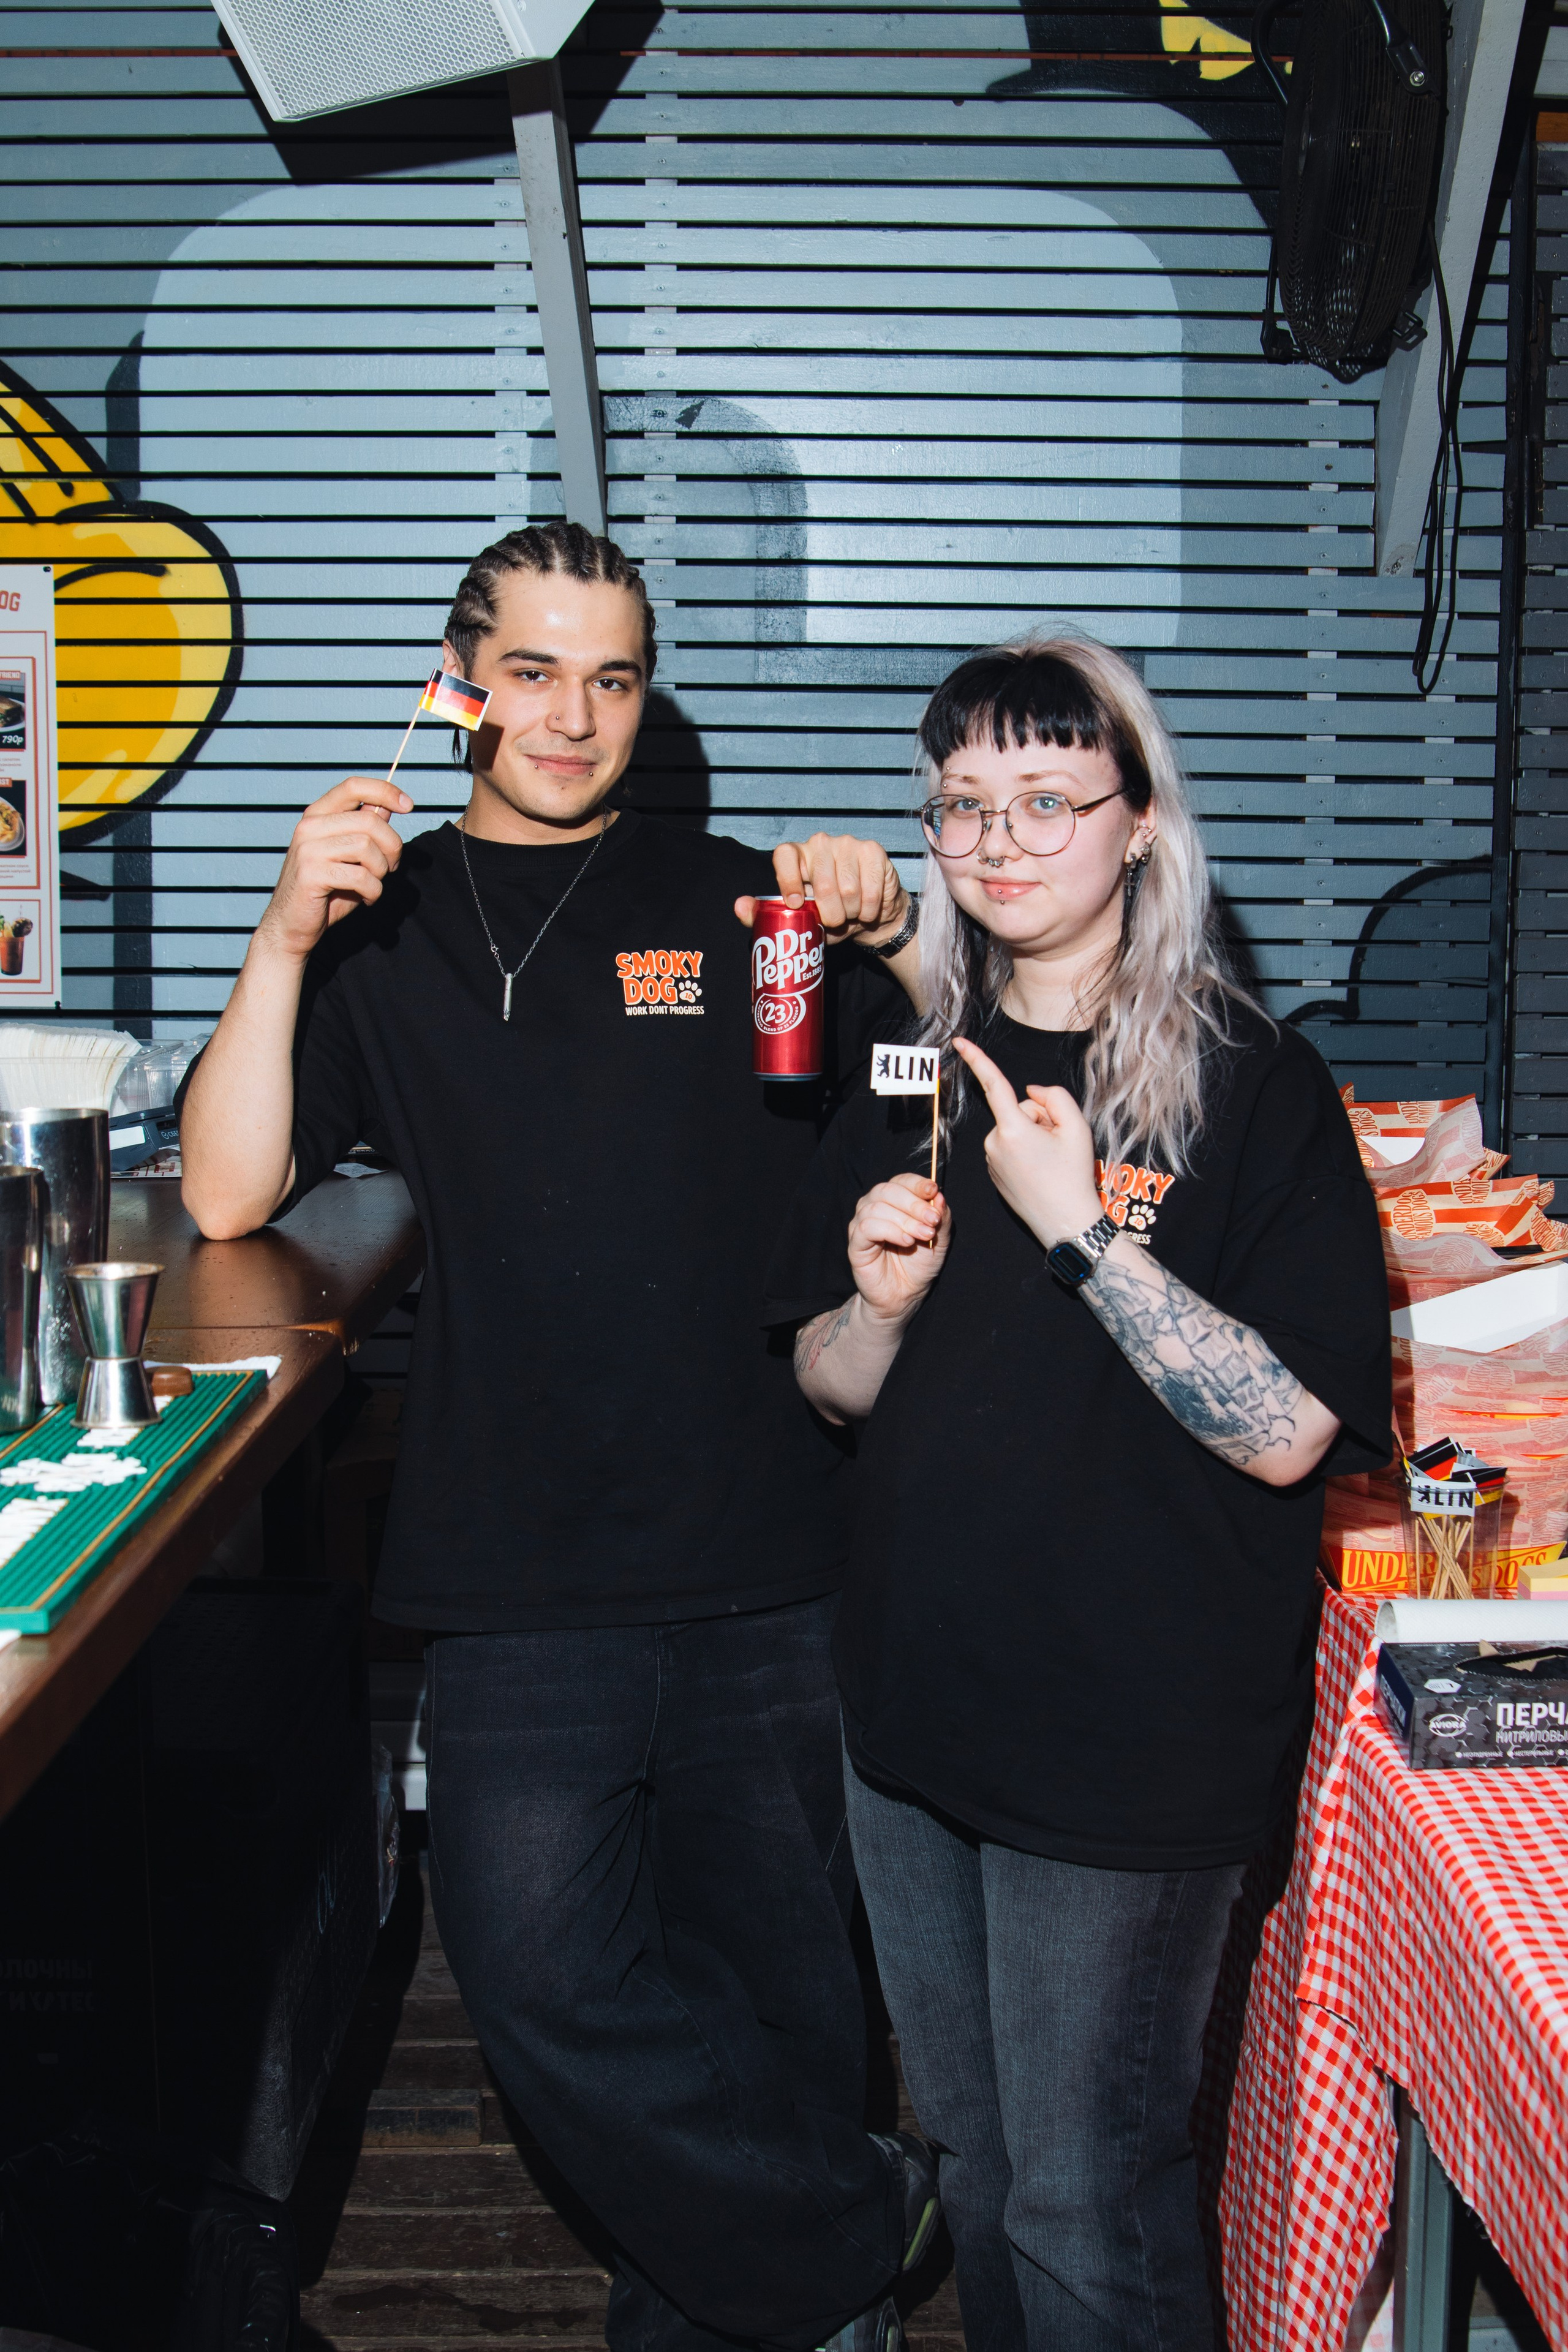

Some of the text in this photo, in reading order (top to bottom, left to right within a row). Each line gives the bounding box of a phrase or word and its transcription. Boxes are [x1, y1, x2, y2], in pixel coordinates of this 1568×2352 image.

[775, 929, 813, 962] Dr
[616, 949, 704, 978] SMOKY
[753, 937, 824, 990] Pepper
[623, 976, 678, 1005] DOG
[625, 1005, 705, 1016] WORK DONT PROGRESS
[765, 1002, 786, 1023] 23
[894, 1055, 935, 1082] LIN
[1134, 1217, 1144, 1227] 10
[1393, 1192, 1418, 1240] UNDERDOG
[1411, 1191, 1433, 1240] FAMOUS DOGS
[1434, 1487, 1474, 1509] LIN
[1496, 1702, 1568, 1727] ПЕРЧ
